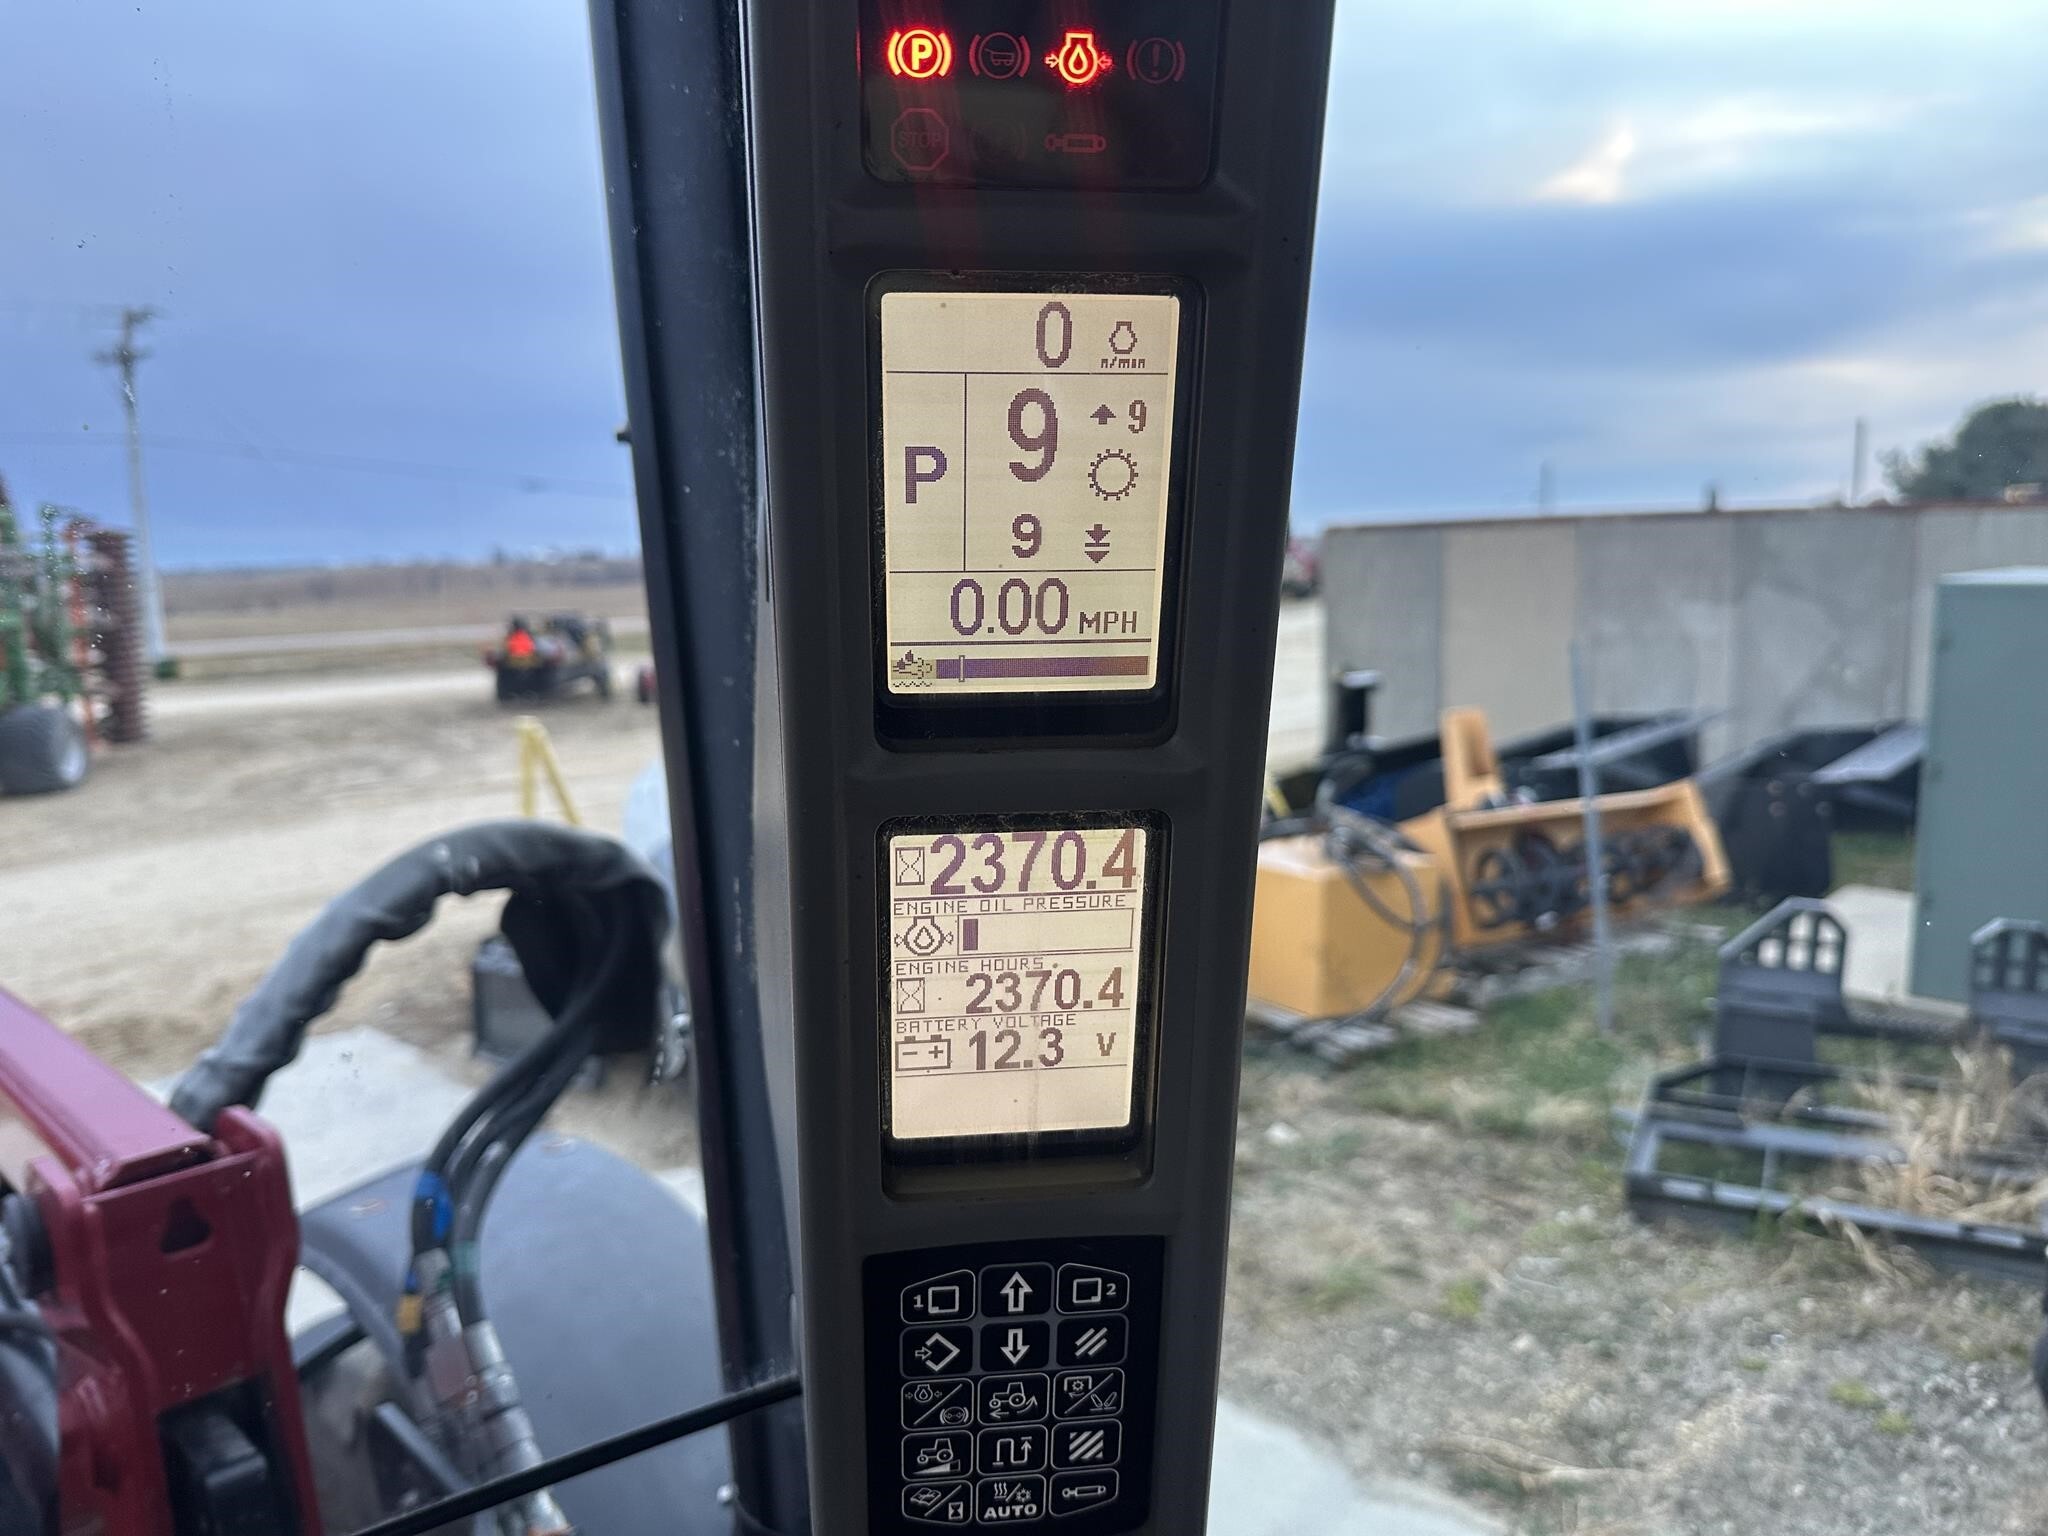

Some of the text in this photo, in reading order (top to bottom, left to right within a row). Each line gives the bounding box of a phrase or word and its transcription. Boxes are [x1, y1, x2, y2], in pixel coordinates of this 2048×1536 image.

[899, 130, 942, 149] STOP
[1036, 301, 1072, 368] 0
[1100, 356, 1146, 369] n/min
[1128, 400, 1147, 433] 9
[1008, 388, 1058, 482] 9
[905, 446, 947, 504] P
[1012, 514, 1042, 558] 9
[951, 578, 1137, 635] 0.00 MPH
[930, 829, 1136, 895] 2370.4
[894, 895, 1126, 915] ENGINE OIL PRESSURE
[896, 957, 1044, 976] ENGINE HOURS
[966, 967, 1124, 1014] 2370.4
[897, 1013, 1077, 1034] BATTERY VOLTAGE
[969, 1027, 1117, 1070] 12.3 V
[913, 1295, 924, 1309] 1
[1106, 1283, 1117, 1296] 2
[984, 1503, 1037, 1520] AUTO
